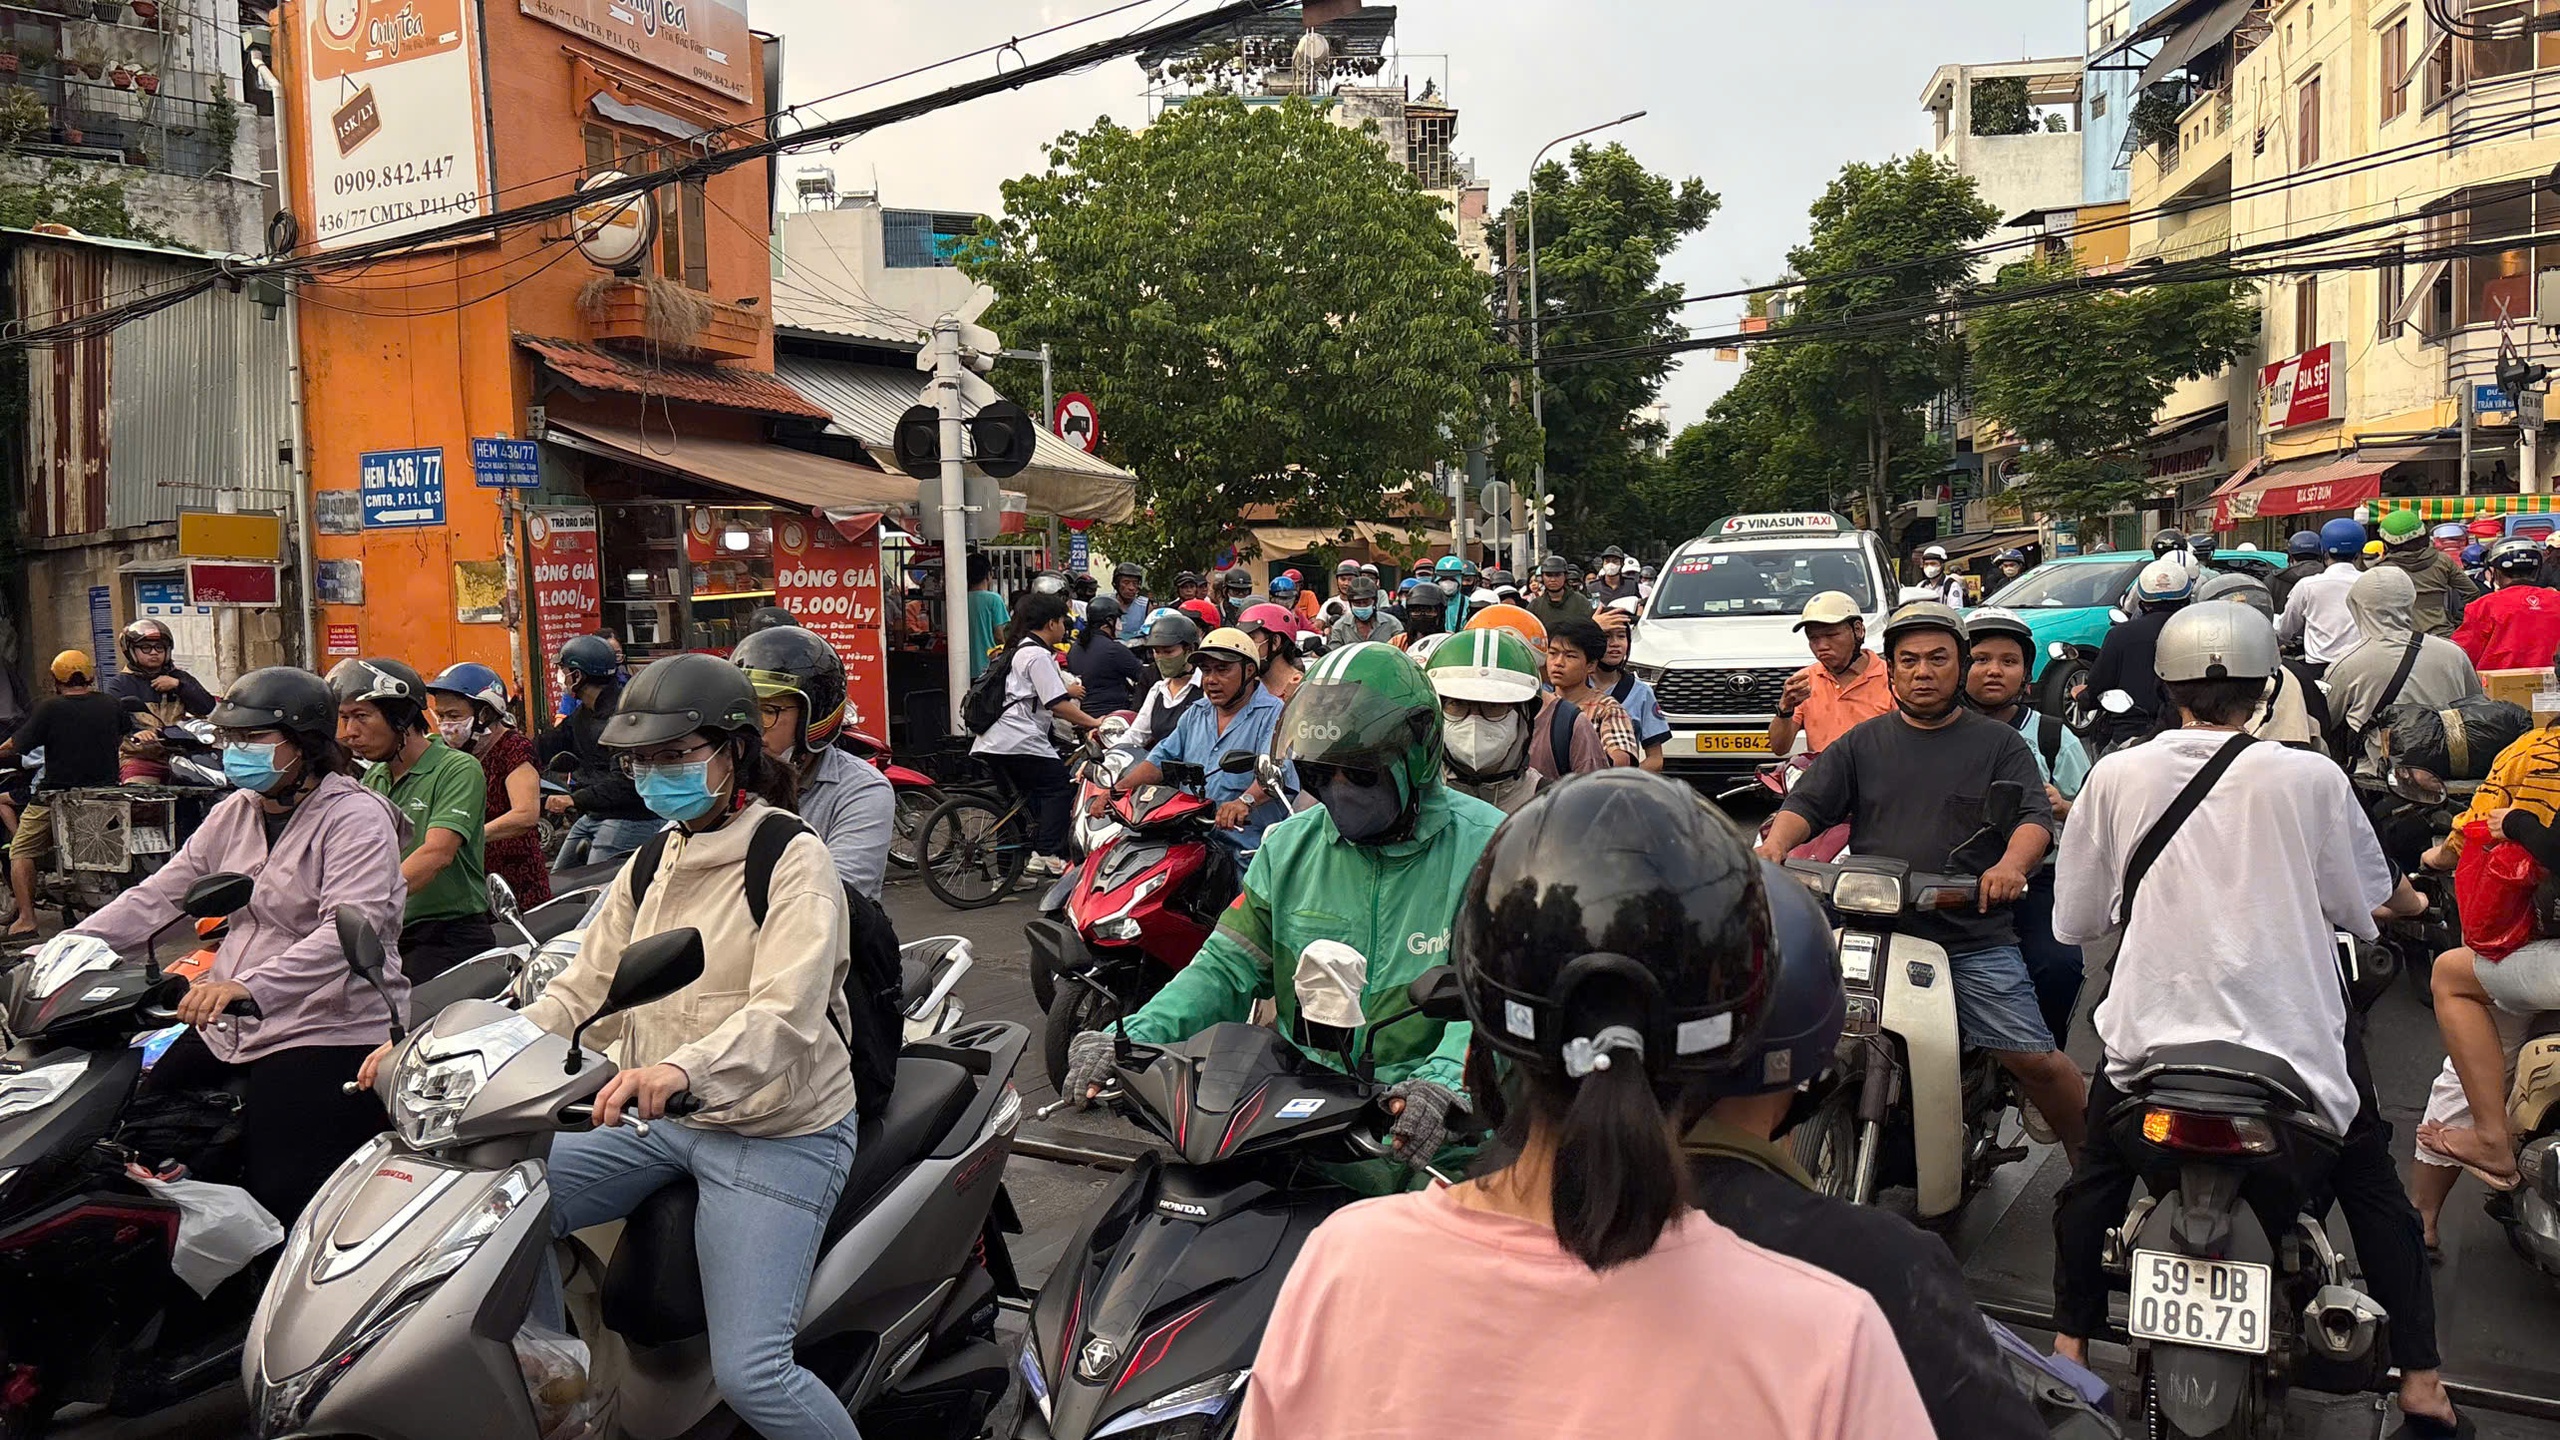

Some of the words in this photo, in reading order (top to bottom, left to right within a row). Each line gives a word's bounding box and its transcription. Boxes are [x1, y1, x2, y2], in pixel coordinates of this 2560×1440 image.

[370, 14, 399, 58] Only
[398, 2, 425, 38] Tea
[535, 1, 571, 26] 436/77
[627, 37, 641, 53] Q3
[334, 155, 454, 196] 0909.842.447
[319, 208, 367, 233] 436/77
[455, 190, 477, 215] Q3
[2299, 368, 2312, 391] BIA
[2314, 358, 2329, 391] SỆT
[476, 441, 498, 458] HẺM
[501, 445, 534, 460] 436/77
[364, 459, 385, 489] HẺM
[365, 493, 396, 509] CMT8,
[398, 492, 422, 507] P.11,
[424, 491, 442, 506] Q.3
[1748, 517, 1804, 529] VINASUN
[1806, 516, 1831, 526] TAXI
[1072, 550, 1087, 559] 239
[535, 557, 569, 582] ĐỒNG
[572, 558, 595, 580] GIÁ
[779, 561, 837, 588] ĐỒNG
[843, 563, 876, 587] GIÁ
[846, 652, 875, 661] Hồng
[1298, 720, 1341, 742] Grab
[1704, 737, 1772, 749] 51G-684.2
[1159, 1199, 1208, 1216] HONDA
[2152, 1258, 2248, 1303] 59-DB
[2140, 1297, 2256, 1345] 086.79
